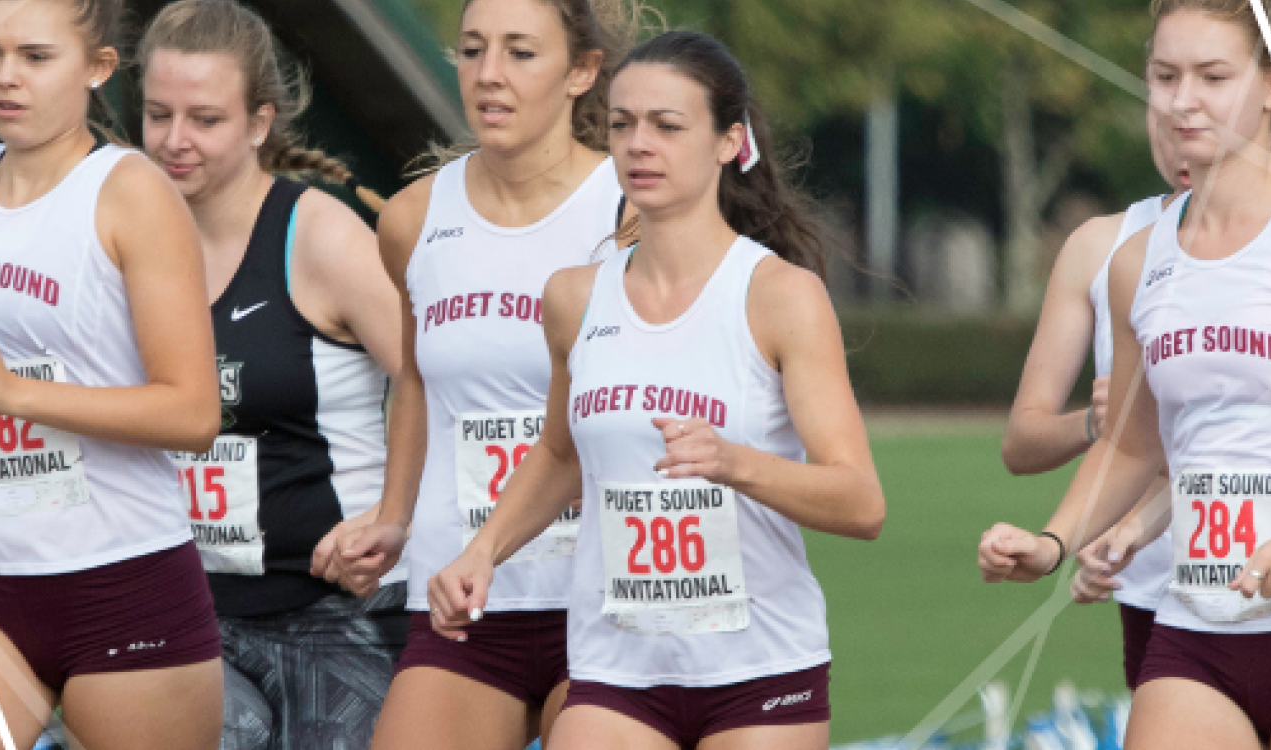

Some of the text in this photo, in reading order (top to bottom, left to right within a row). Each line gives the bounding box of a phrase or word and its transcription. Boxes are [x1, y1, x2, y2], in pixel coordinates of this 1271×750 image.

[424, 291, 544, 334] PUGET SOU
[572, 384, 728, 429] PUGET SOUND
[462, 417, 517, 441] PUGET
[604, 487, 723, 512] PUGET SOUND
[1179, 473, 1213, 495] PUGET
[624, 514, 707, 576] 286
[1188, 499, 1258, 560] 284
[611, 573, 733, 601] INVITATIONAL
